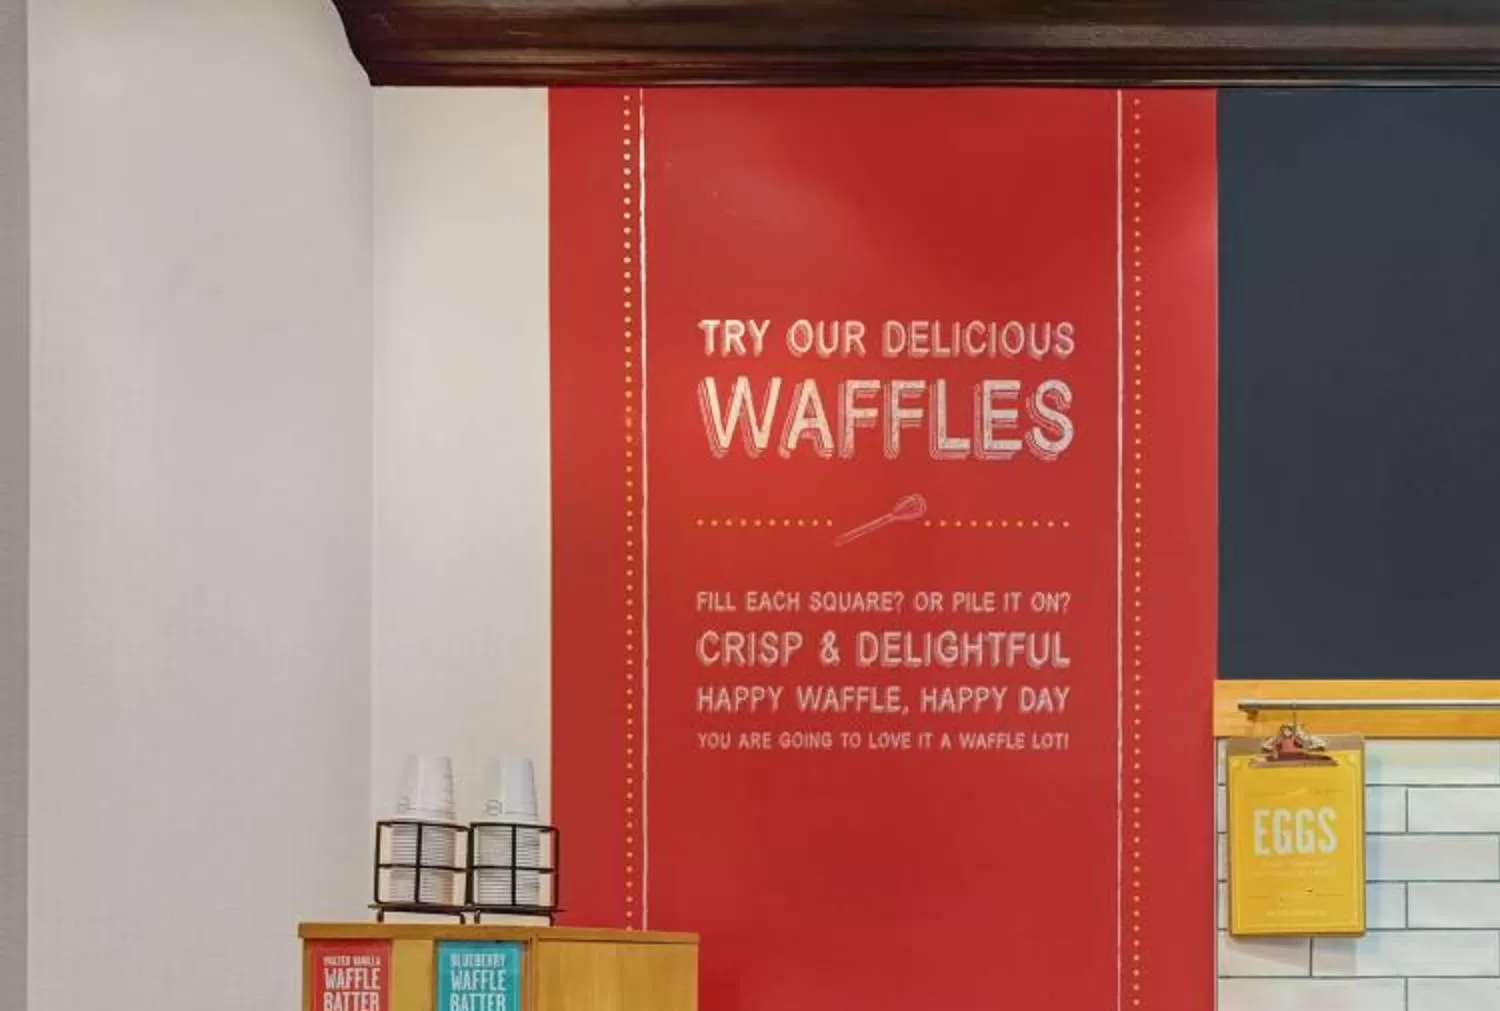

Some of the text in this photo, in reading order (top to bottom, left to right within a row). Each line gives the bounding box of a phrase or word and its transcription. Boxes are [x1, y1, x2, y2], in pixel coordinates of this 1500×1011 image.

[697, 318, 1075, 359] TRY OUR DELICIOUS
[696, 375, 1075, 461] WAFFLES
[696, 590, 1072, 614] FILL EACH SQUARE? OR PILE IT ON?
[696, 628, 1071, 668] CRISP & DELIGHTFUL
[696, 685, 1070, 716] HAPPY WAFFLE, HAPPY DAY
[697, 732, 732, 750] YOU
[738, 731, 772, 749] ARE
[778, 731, 833, 750] GOING
[840, 732, 862, 749] TO
[868, 731, 912, 750] LOVE
[918, 732, 934, 749] IT
[940, 732, 952, 749] A
[959, 732, 1025, 750] WAFFLE
[1253, 806, 1338, 857] EGGS
[324, 967, 381, 990] WAFFLE
[451, 969, 507, 991] WAFFLE
